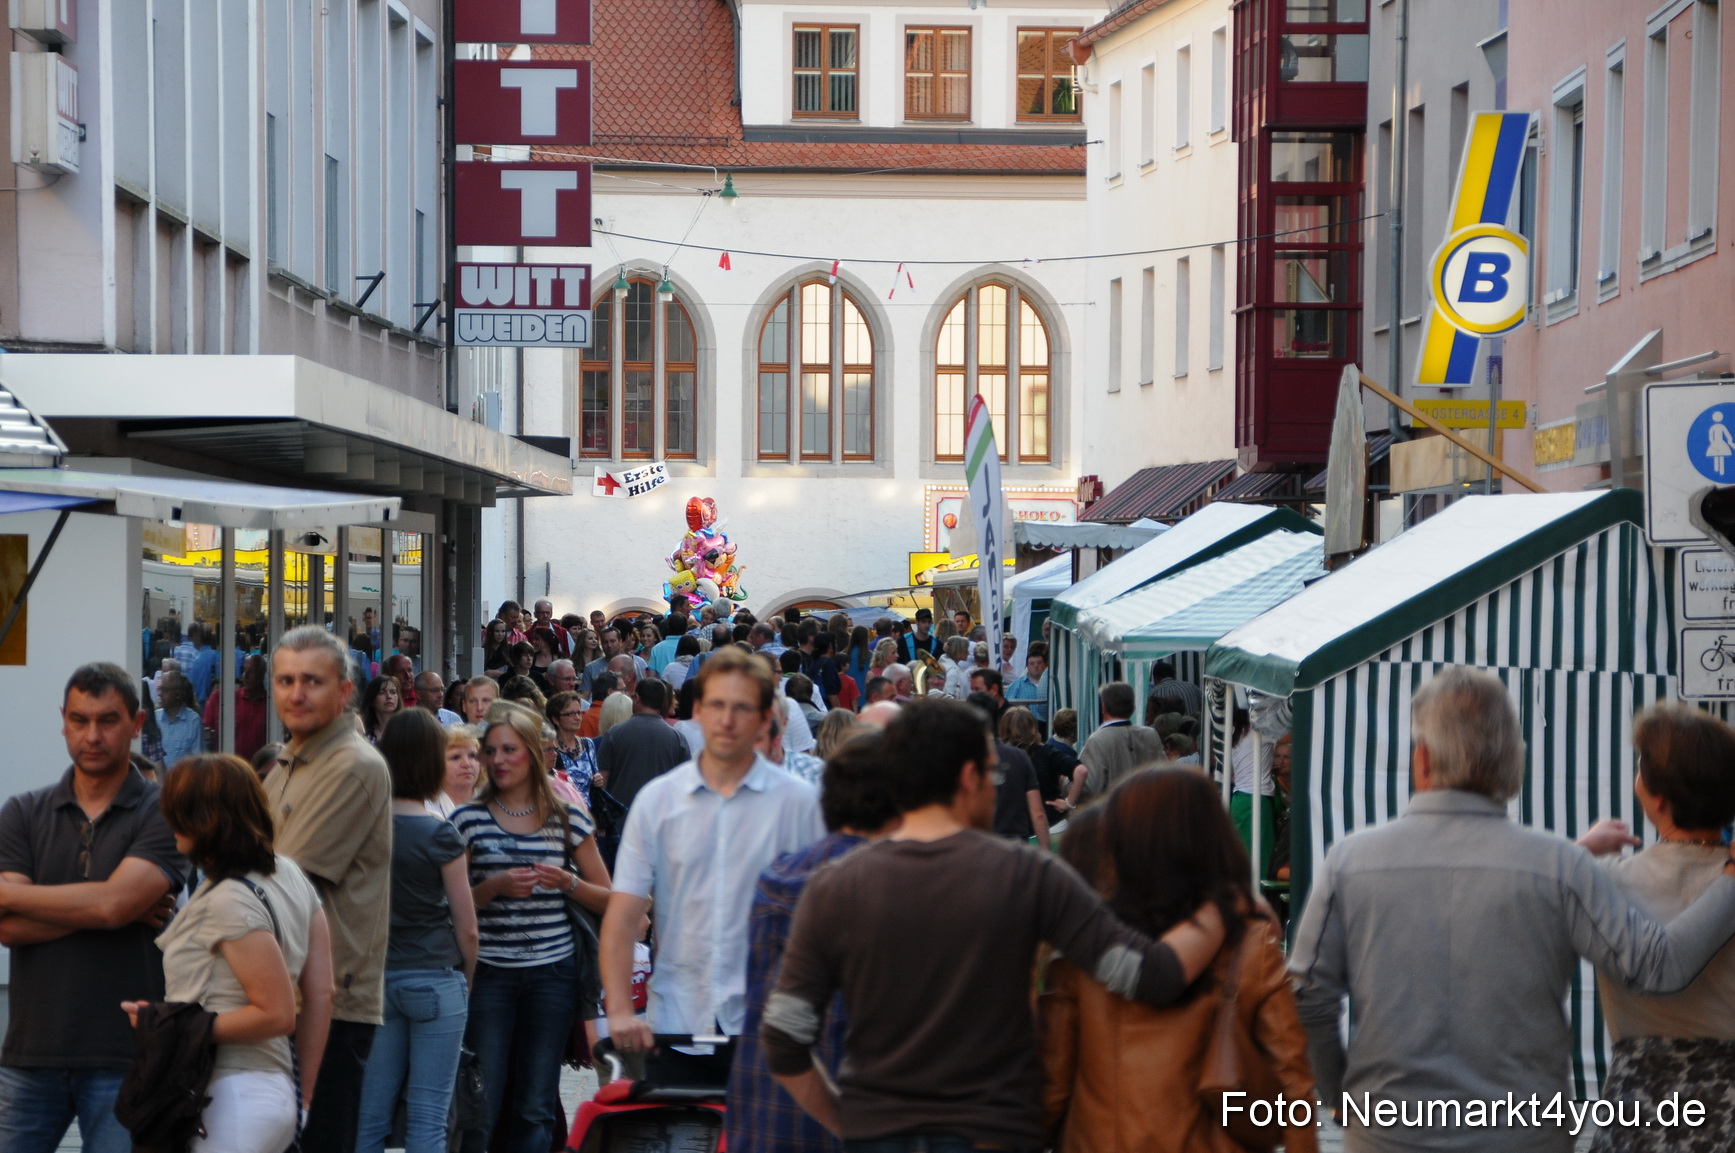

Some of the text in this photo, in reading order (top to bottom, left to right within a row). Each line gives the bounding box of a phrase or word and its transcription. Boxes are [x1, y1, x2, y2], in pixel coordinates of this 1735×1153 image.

[461, 266, 586, 306] WITT
[1458, 251, 1511, 303] B
[458, 313, 587, 342] WEIDEN
[1512, 408, 1519, 420] 4
[623, 465, 664, 484] Erste
[628, 475, 665, 497] Hilfe
